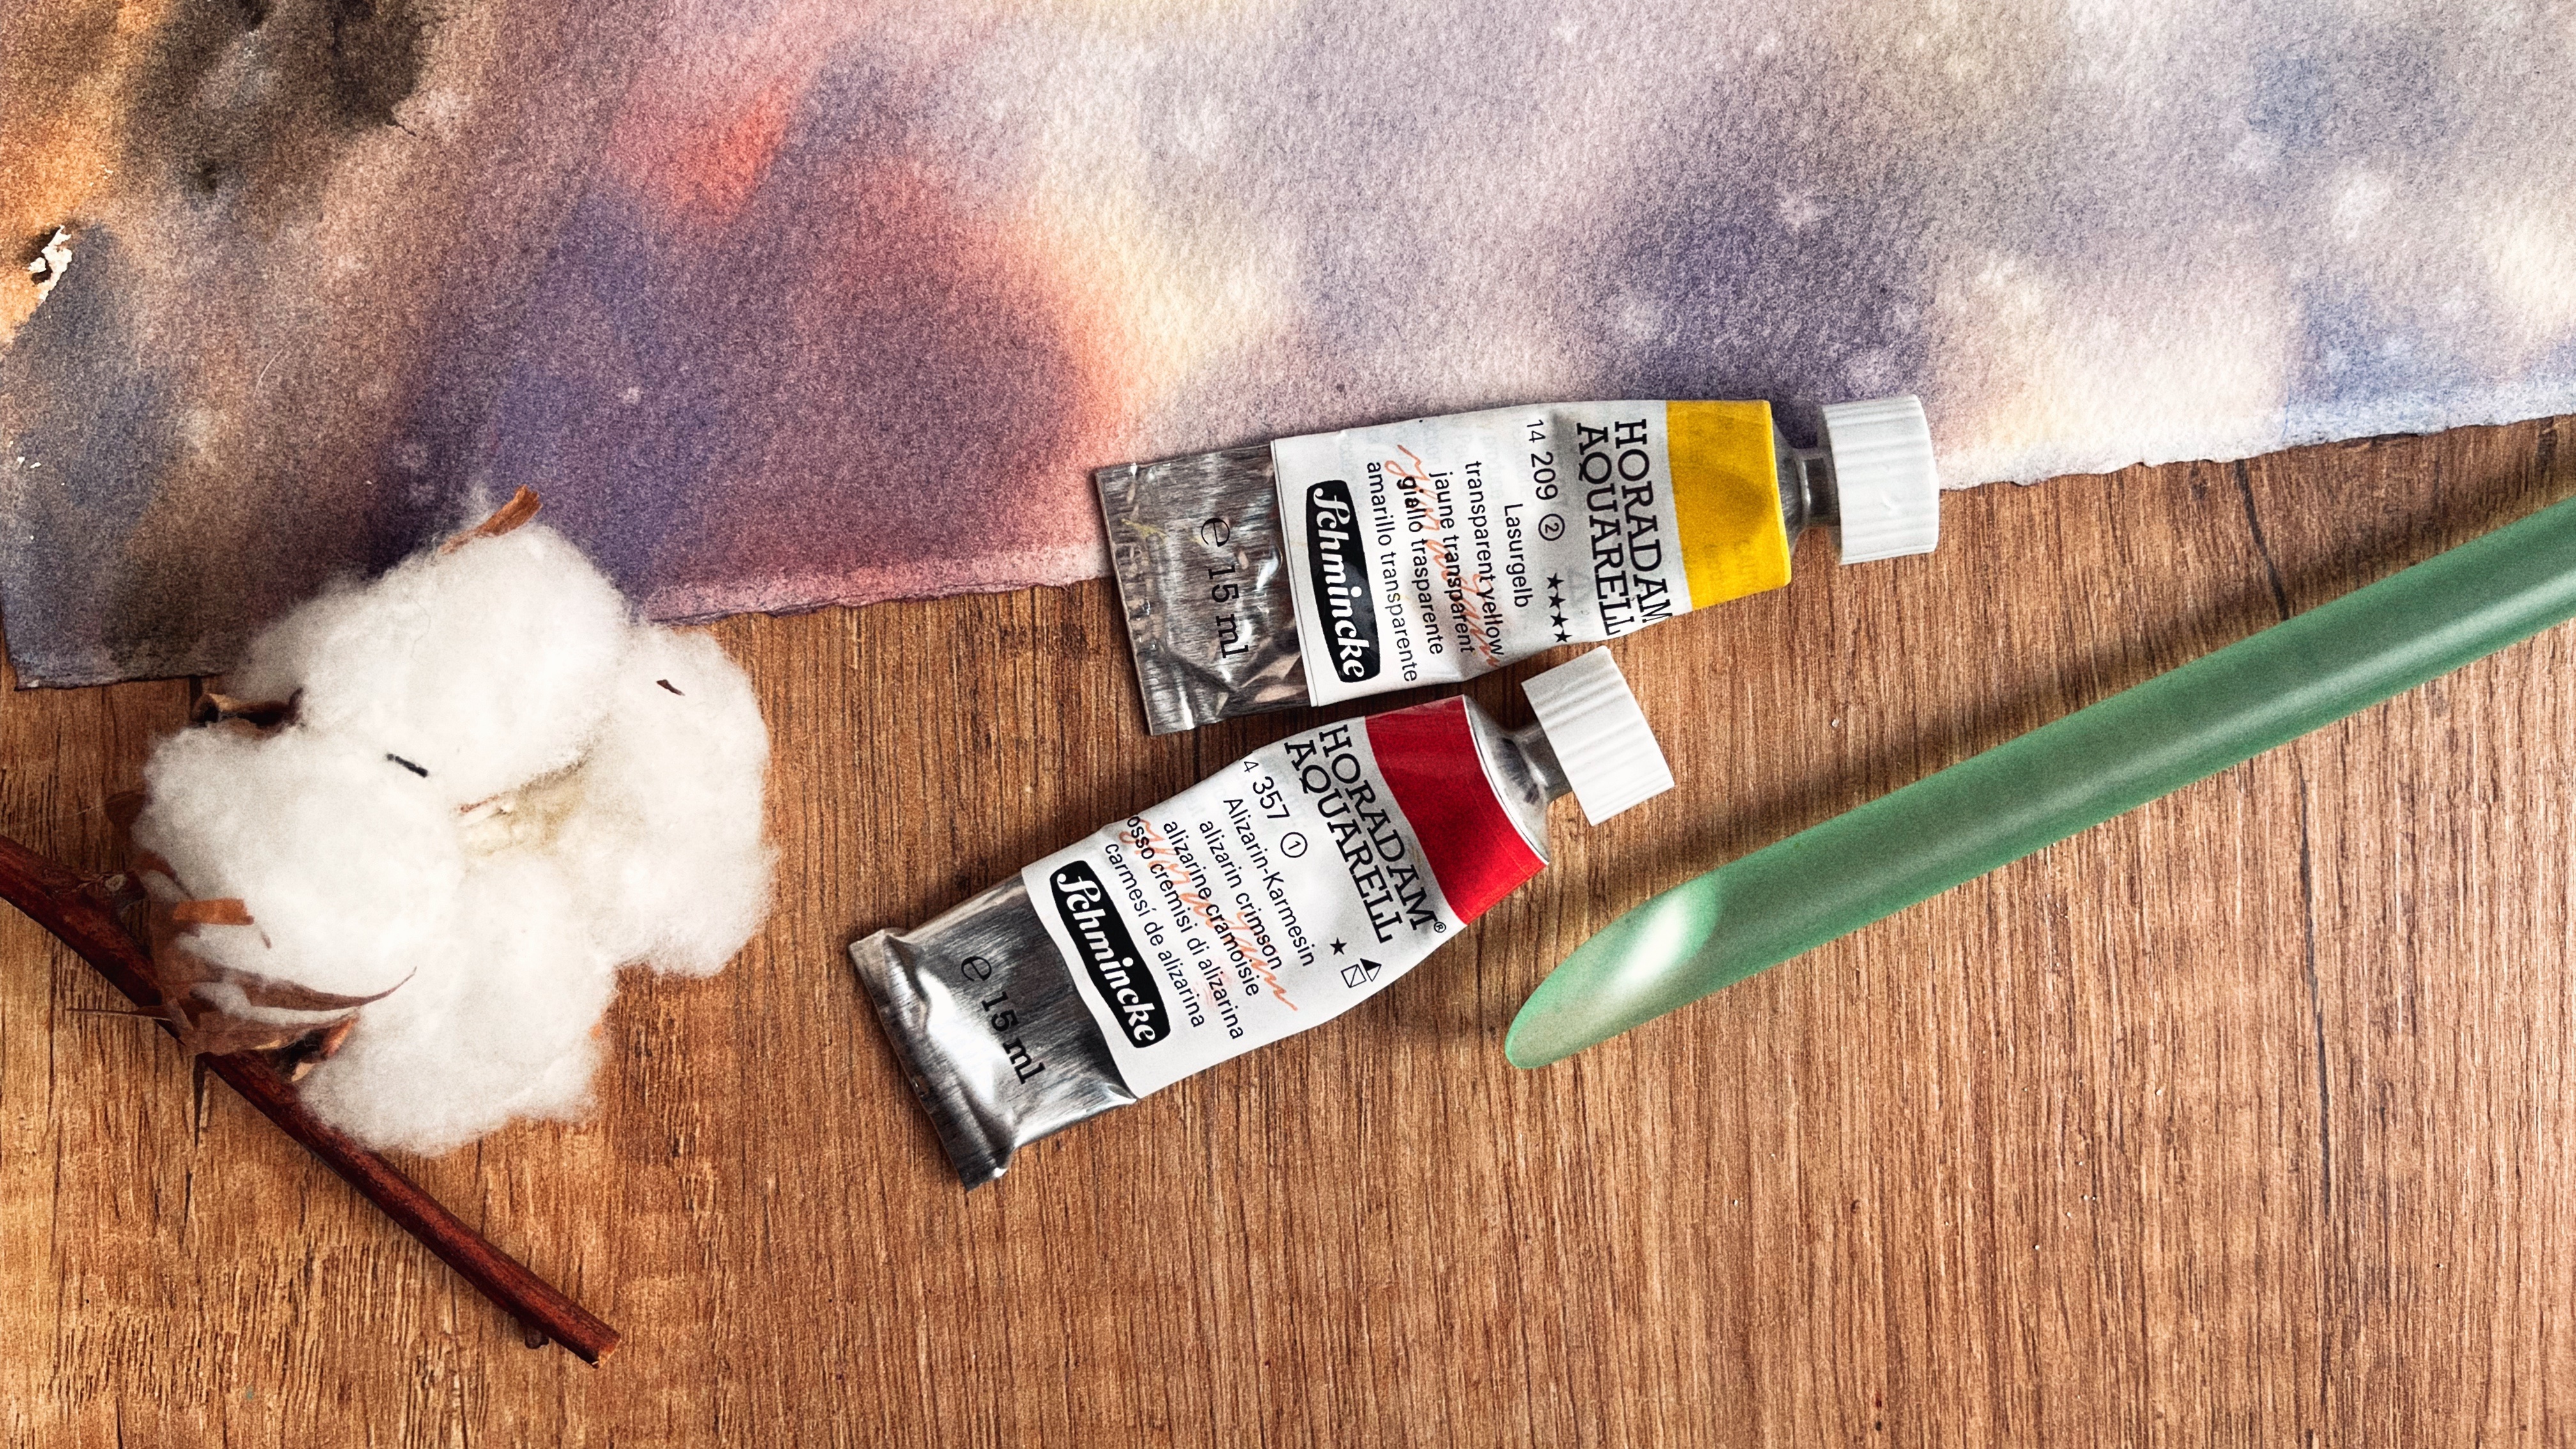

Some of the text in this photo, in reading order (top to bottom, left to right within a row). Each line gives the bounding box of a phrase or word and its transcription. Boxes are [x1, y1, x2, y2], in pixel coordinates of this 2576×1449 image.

[1526, 419, 1545, 442] 14
[1531, 452, 1559, 500] 209
[1208, 565, 1239, 602] 15
[1314, 487, 1370, 677] Schmincke
[1367, 462, 1417, 682] amarillo transparente
[1396, 475, 1443, 654] giallo trasparente
[1429, 471, 1455, 529] jaune
[1443, 535, 1475, 654] transparent
[1465, 461, 1496, 583] transparent
[1504, 503, 1533, 608] Lasurgelb
[1577, 423, 1634, 636] AQUARELL
[1615, 419, 1673, 623] HORADAM
[1216, 614, 1249, 658] ml
[1476, 586, 1505, 659] yellow
[1252, 776, 1291, 818] 357
[1284, 739, 1402, 943] AQUARELL
[1057, 873, 1156, 1041] Schmincke
[1105, 843, 1204, 1027] carmesí de alizarina
[1126, 816, 1243, 1039] osso cremisi di alizarina
[1164, 821, 1260, 996] alizarine cramoisie
[1199, 822, 1282, 970] alizarin crimson
[1223, 799, 1315, 967] Alizarin-Karmesin
[981, 991, 1020, 1031] 15
[1002, 1038, 1046, 1085] ml
